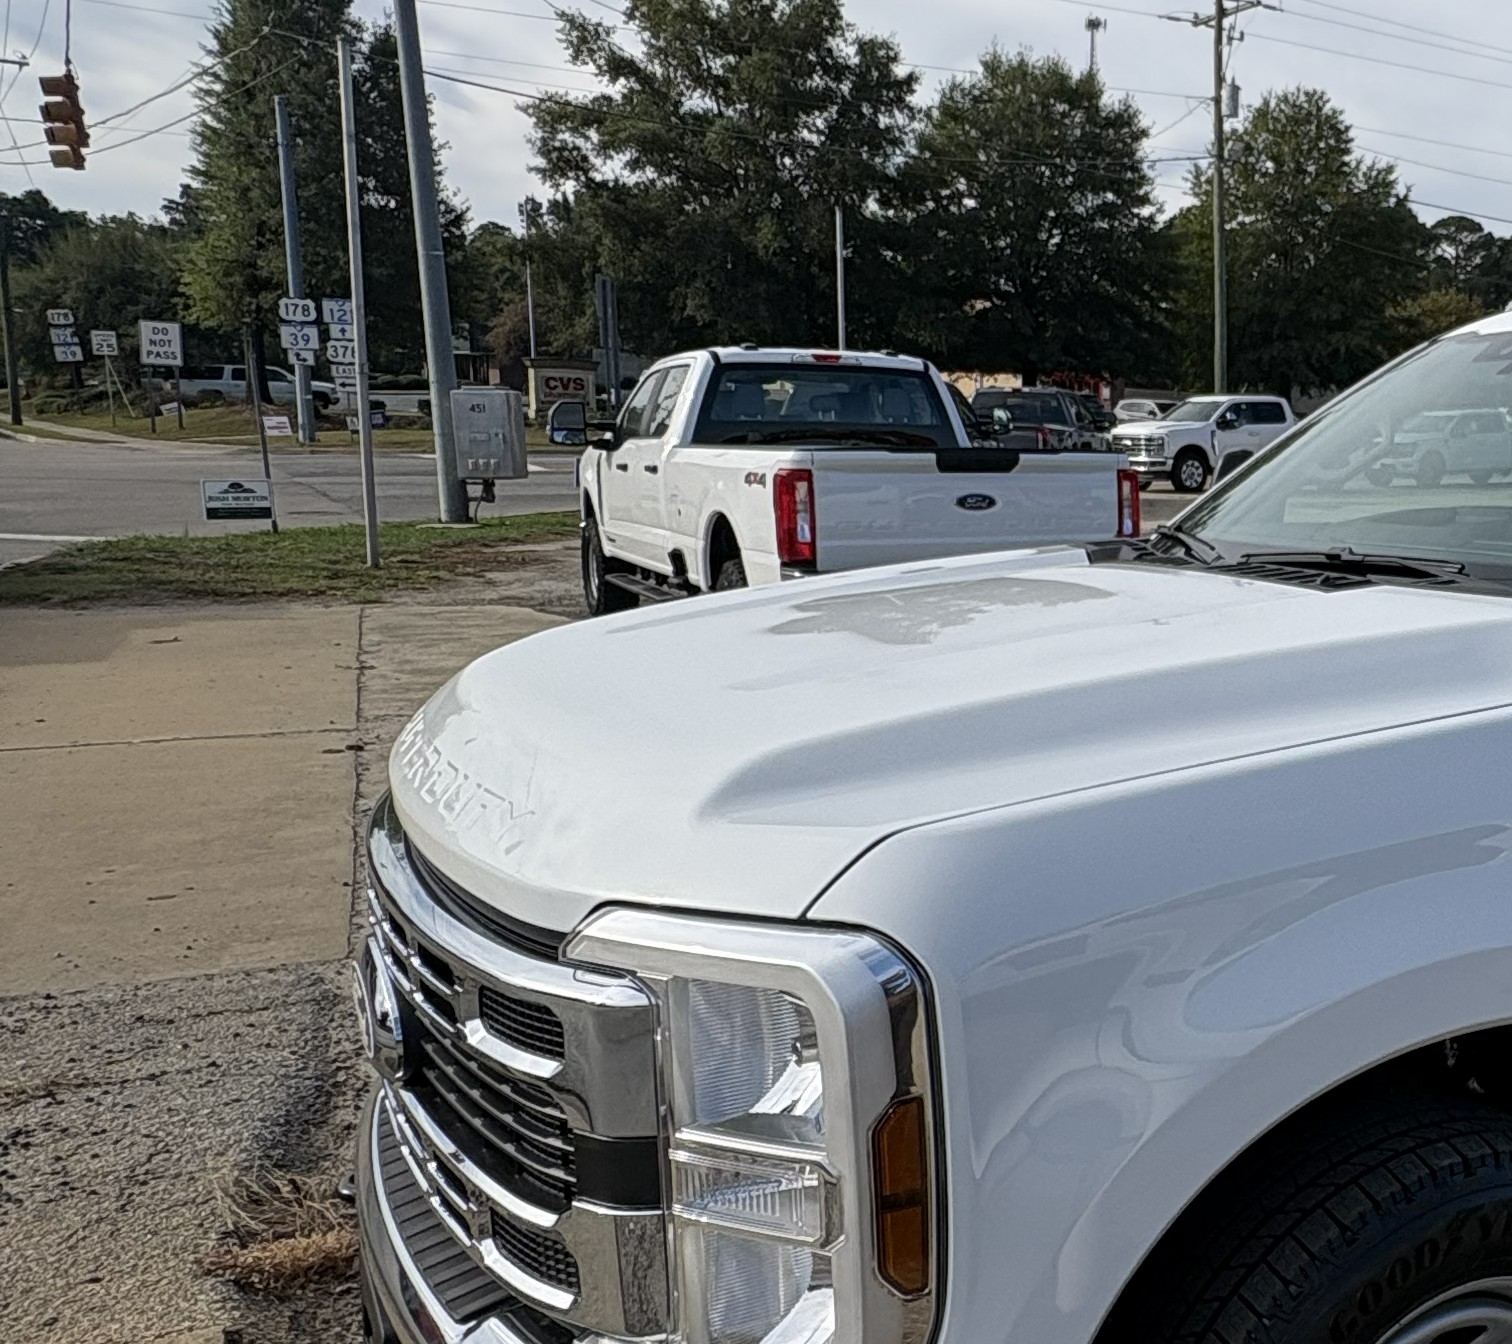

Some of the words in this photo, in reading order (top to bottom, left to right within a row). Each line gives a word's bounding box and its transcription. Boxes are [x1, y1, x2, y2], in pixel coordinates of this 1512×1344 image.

[284, 302, 311, 317] 178
[152, 326, 169, 336] DO
[149, 338, 173, 348] NOT
[289, 332, 311, 347] 39
[95, 342, 116, 353] 25
[61, 350, 78, 360] 39
[146, 350, 178, 361] PASS
[544, 376, 585, 391] CVS
[469, 404, 486, 414] 451
